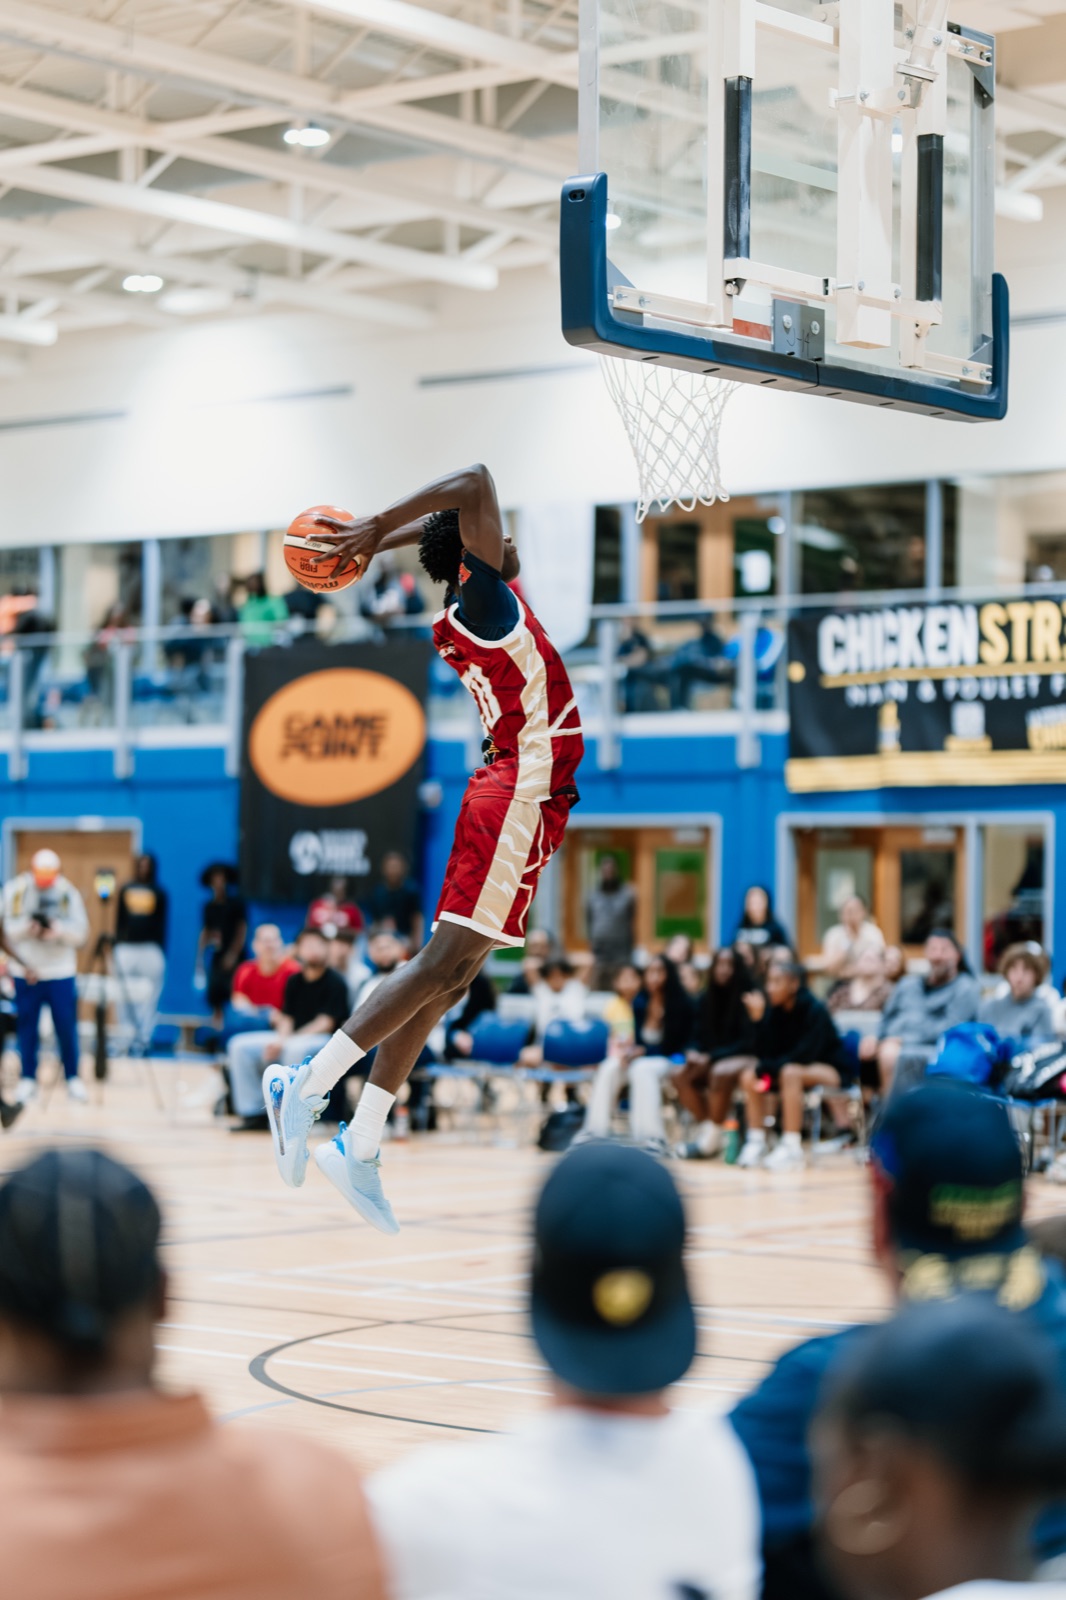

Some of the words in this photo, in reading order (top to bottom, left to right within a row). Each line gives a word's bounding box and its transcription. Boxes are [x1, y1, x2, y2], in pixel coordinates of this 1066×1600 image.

[300, 561, 318, 573] FIBA
[917, 679, 936, 703] &
[282, 711, 389, 737] GAME
